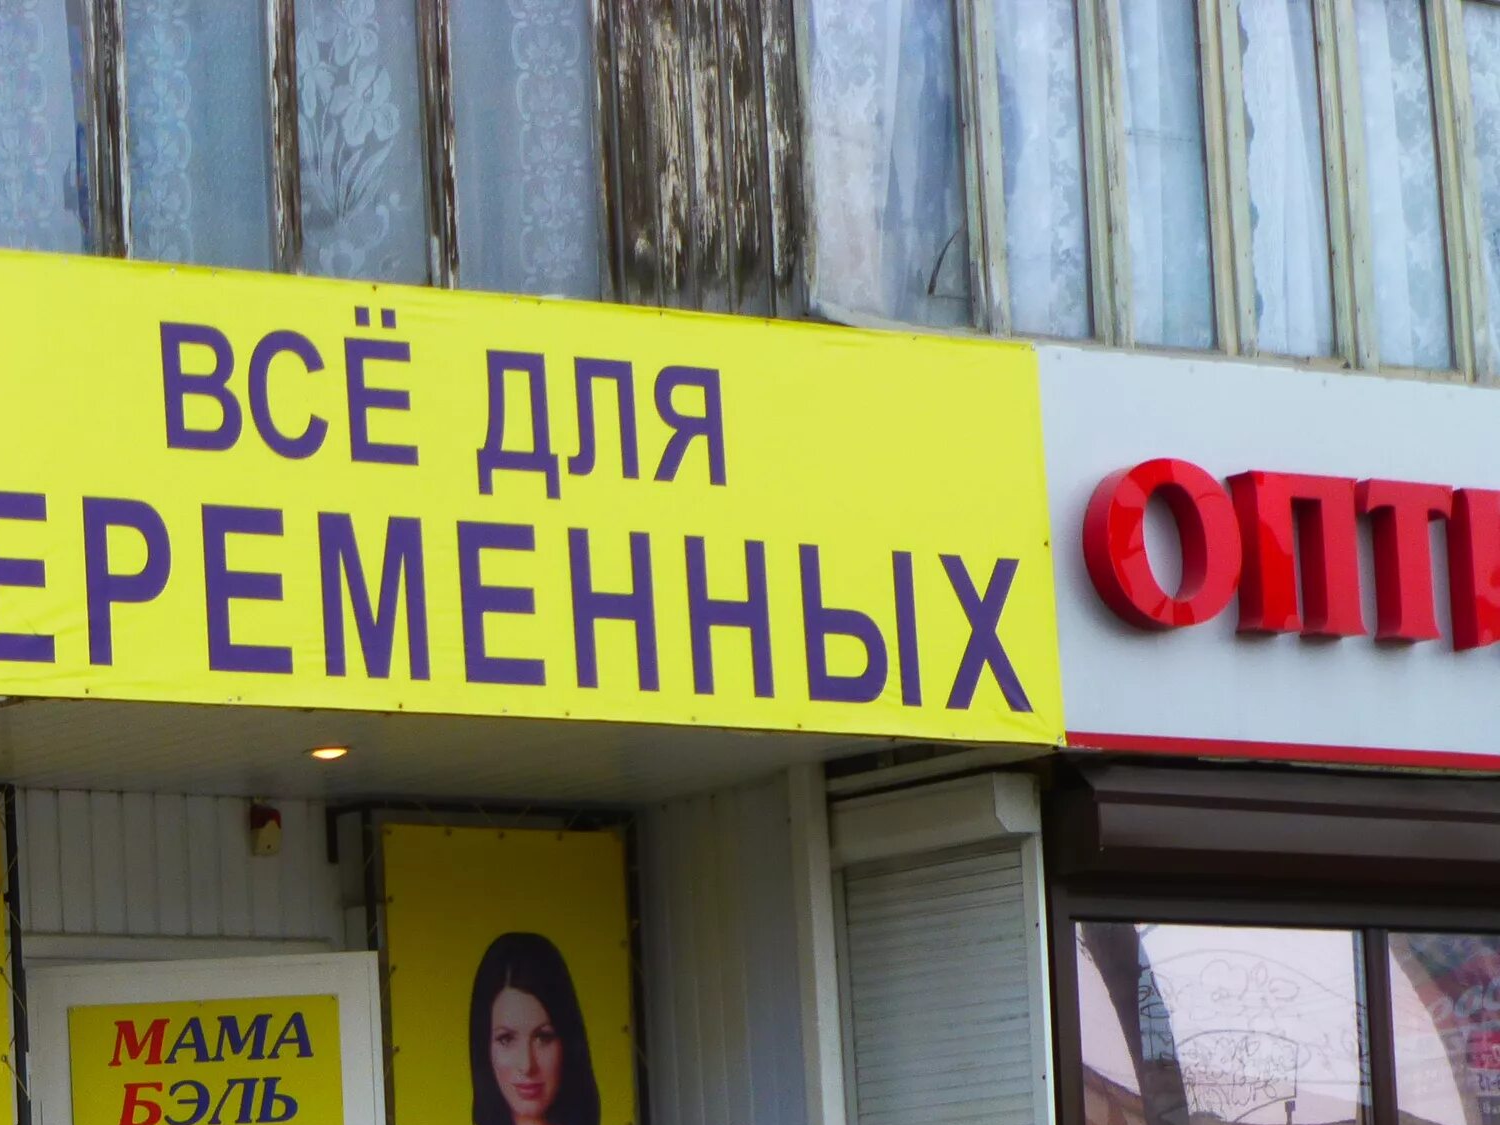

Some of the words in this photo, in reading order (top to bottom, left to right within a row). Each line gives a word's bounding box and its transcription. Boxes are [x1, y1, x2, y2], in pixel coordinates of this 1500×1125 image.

[160, 306, 420, 465] ВСЁ
[477, 349, 727, 498] ДЛЯ
[108, 1011, 314, 1067] МАМА
